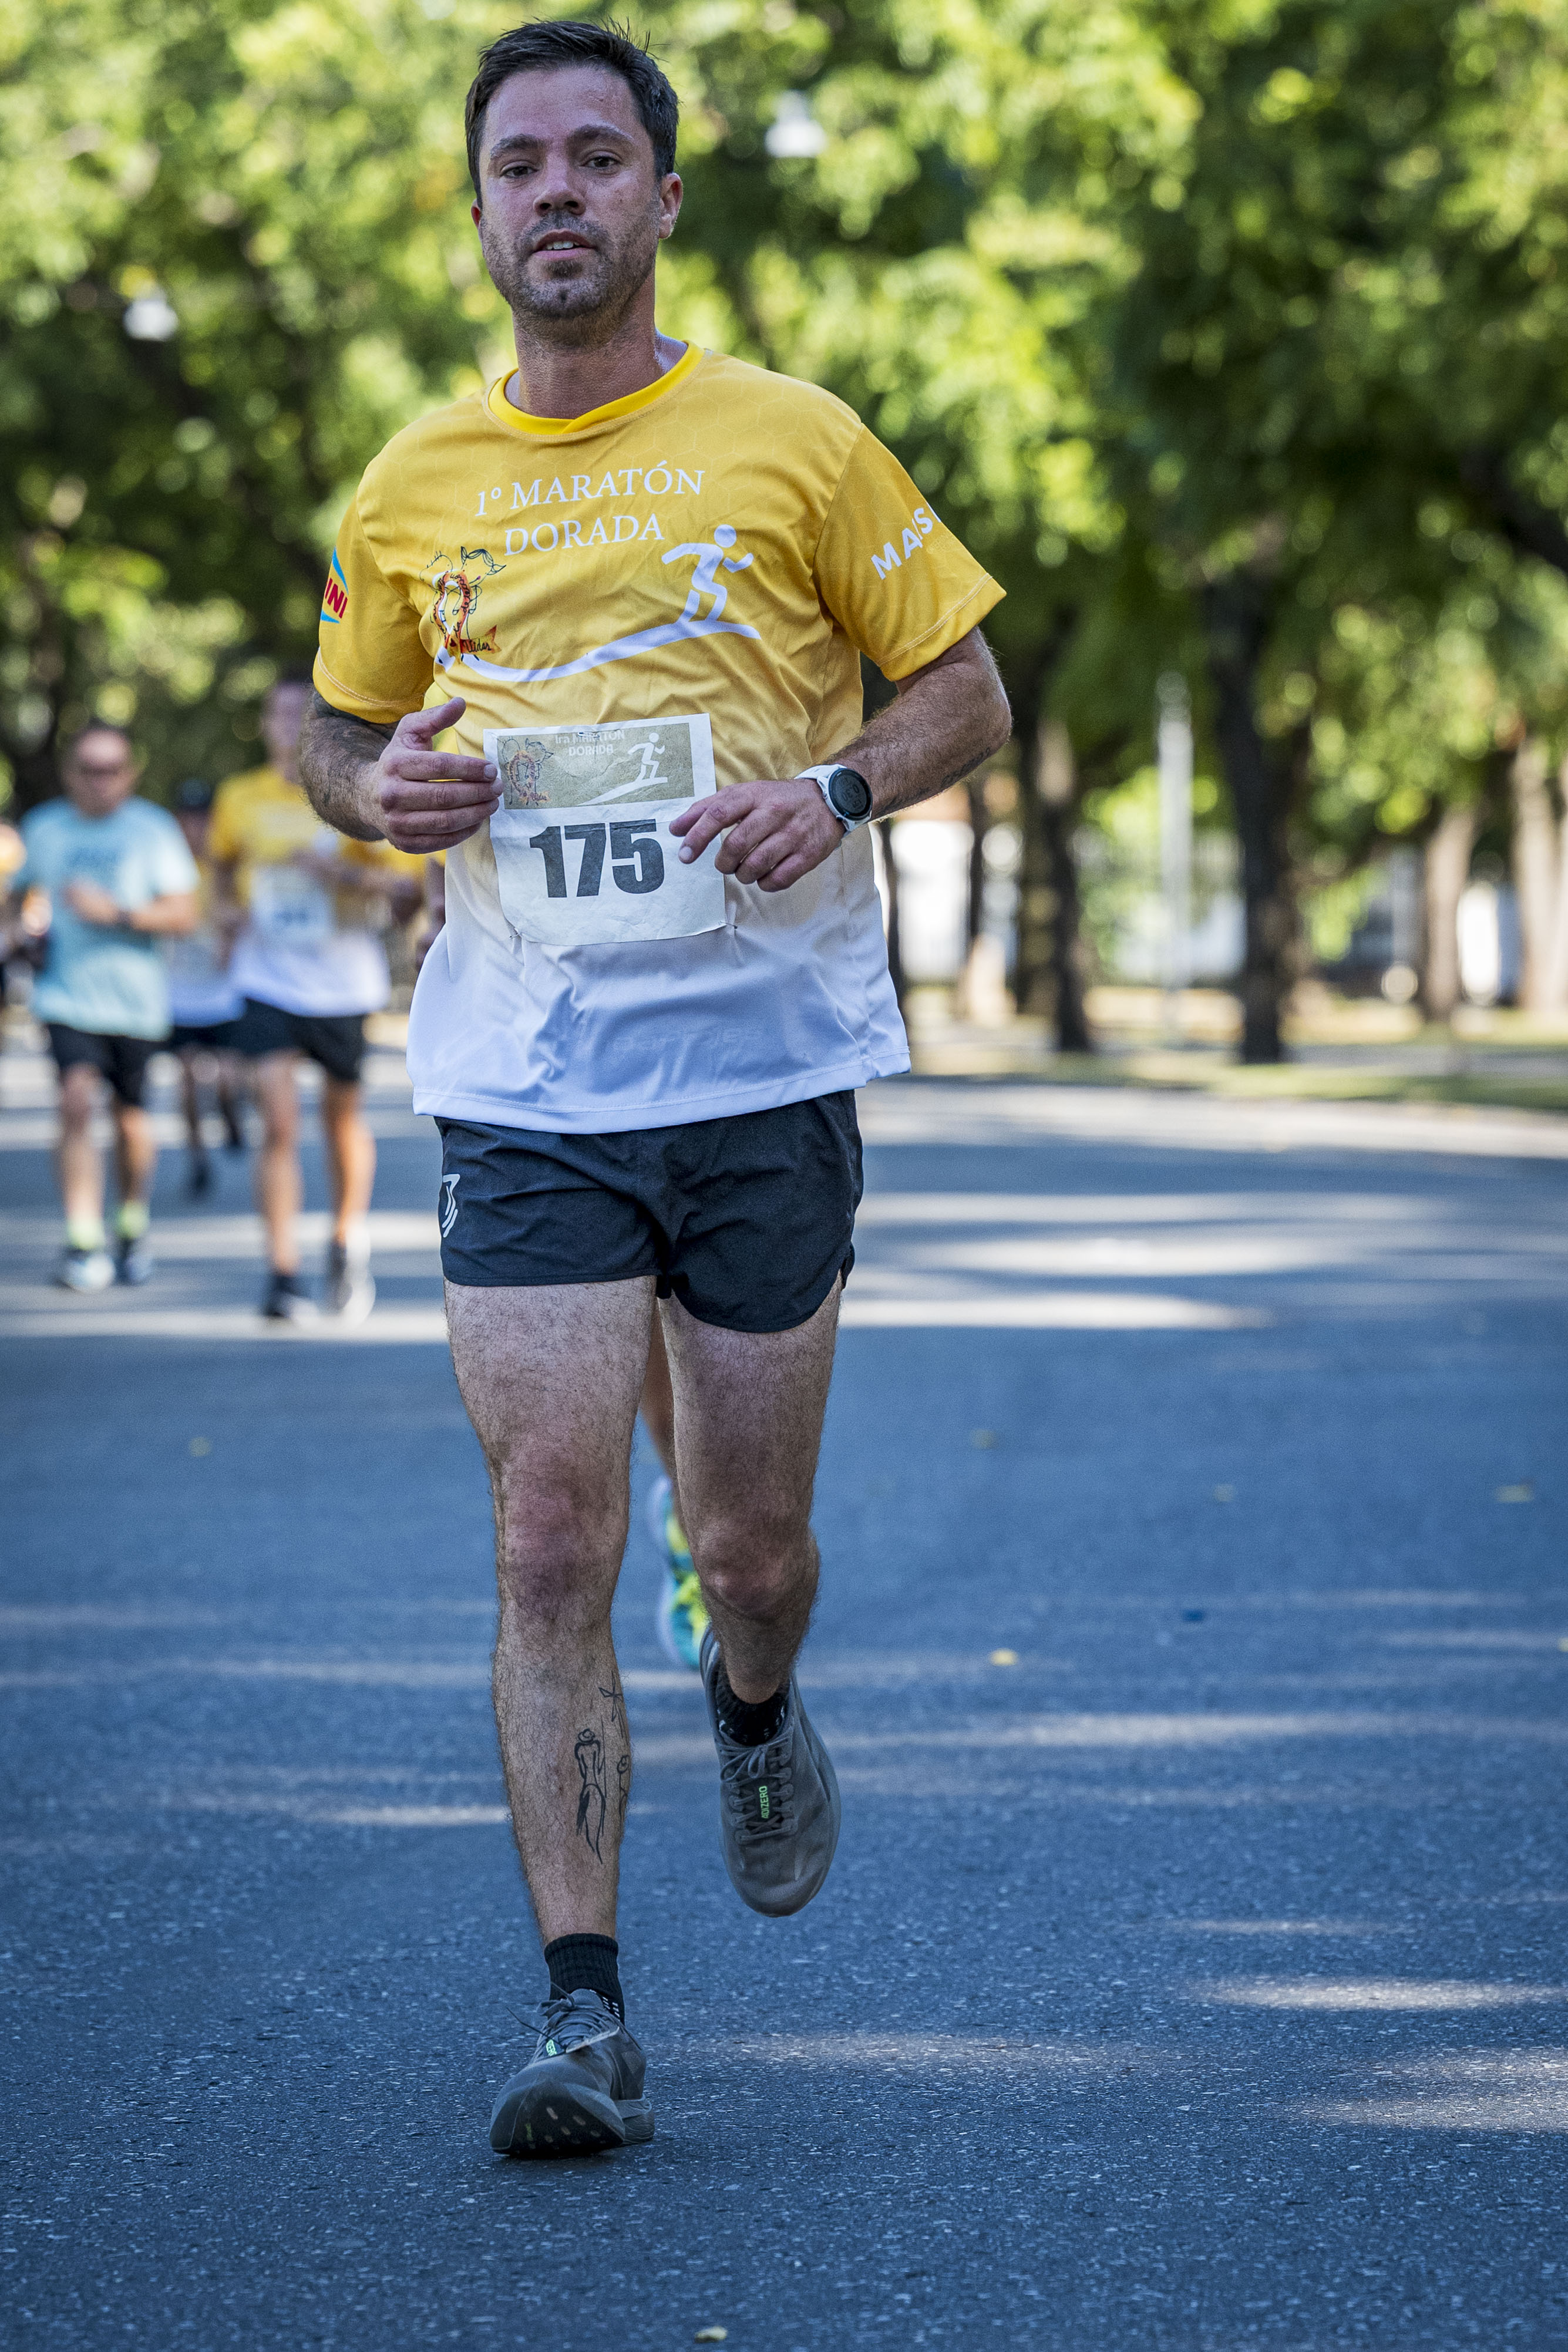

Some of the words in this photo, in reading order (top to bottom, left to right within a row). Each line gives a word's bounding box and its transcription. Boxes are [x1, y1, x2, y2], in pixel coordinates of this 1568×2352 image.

[510, 460, 705, 510] MARATÓN
[504, 513, 665, 556] DORADA
[568, 744, 613, 756] DORADA
[529, 819, 665, 899] 175
[759, 1785, 769, 1818] ADIZERO
